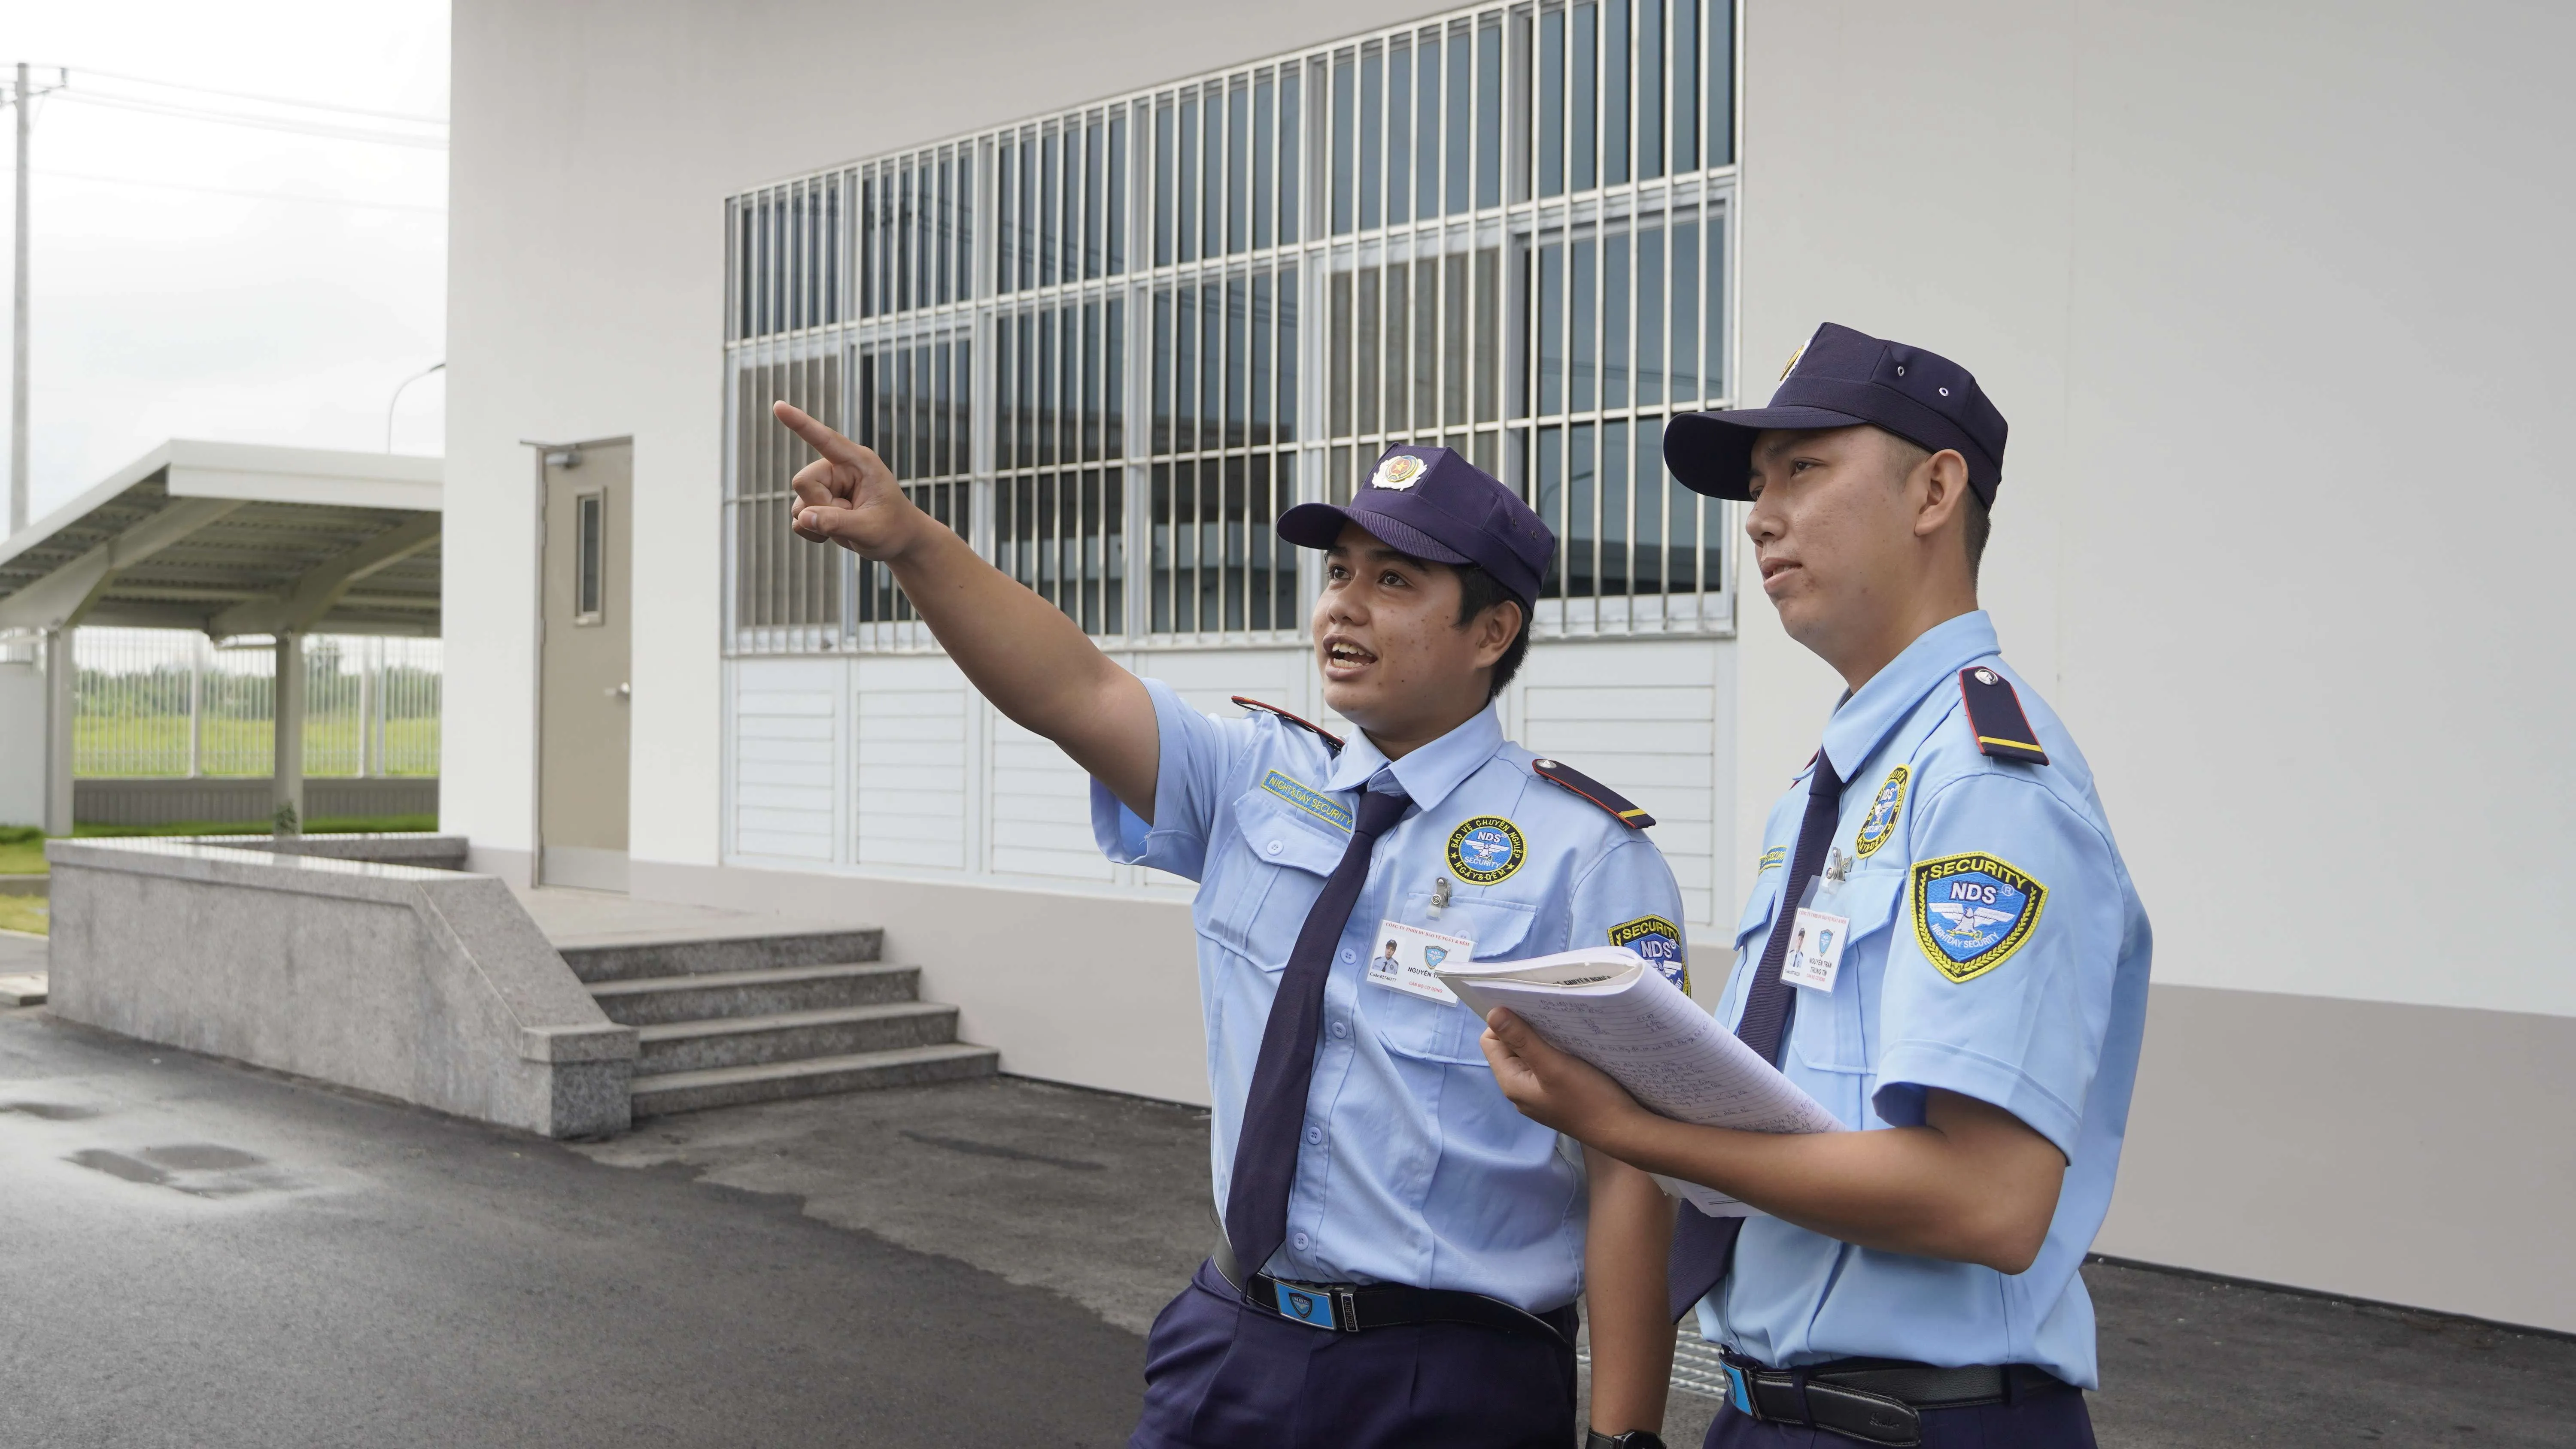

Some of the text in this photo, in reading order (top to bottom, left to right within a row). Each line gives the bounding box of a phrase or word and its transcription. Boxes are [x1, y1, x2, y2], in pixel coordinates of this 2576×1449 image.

[1311, 798, 1352, 825] SECURITY
[1477, 831, 1501, 843] NDS
[1464, 856, 1501, 868] SECURITY
[1930, 859, 2028, 890] SECURITY
[1950, 882, 1996, 905] NDS
[1622, 921, 1680, 943] SECURITY
[1963, 931, 1999, 948] SECURITY
[1641, 940, 1673, 959] NDS
[1344, 1300, 1354, 1327] SECURITY
